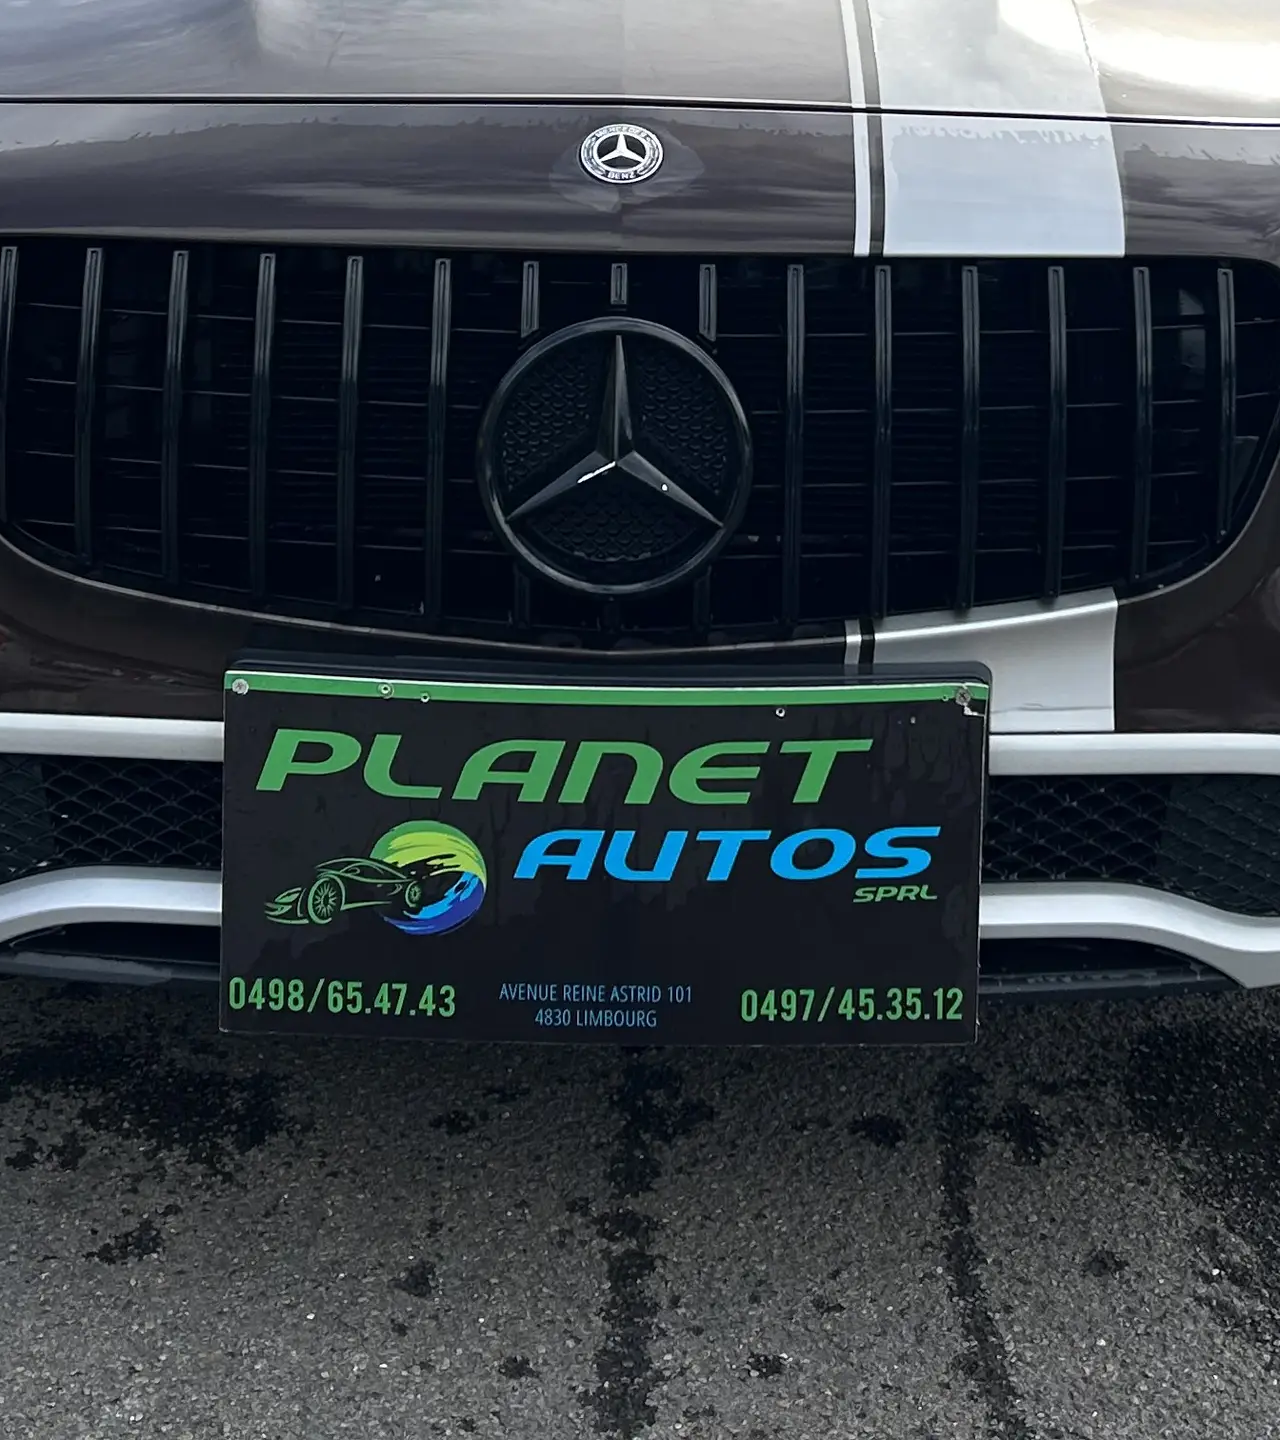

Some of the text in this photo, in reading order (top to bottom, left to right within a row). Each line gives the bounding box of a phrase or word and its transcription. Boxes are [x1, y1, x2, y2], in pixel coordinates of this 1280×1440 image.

[255, 728, 874, 805] PLANET
[513, 826, 941, 882] AUTOS
[853, 884, 938, 903] SPRL
[229, 976, 456, 1017] 0498/65.47.43
[499, 983, 692, 1003] AVENUE REINE ASTRID 101
[741, 987, 964, 1022] 0497/45.35.12
[534, 1008, 657, 1027] 4830 LIMBOURG
